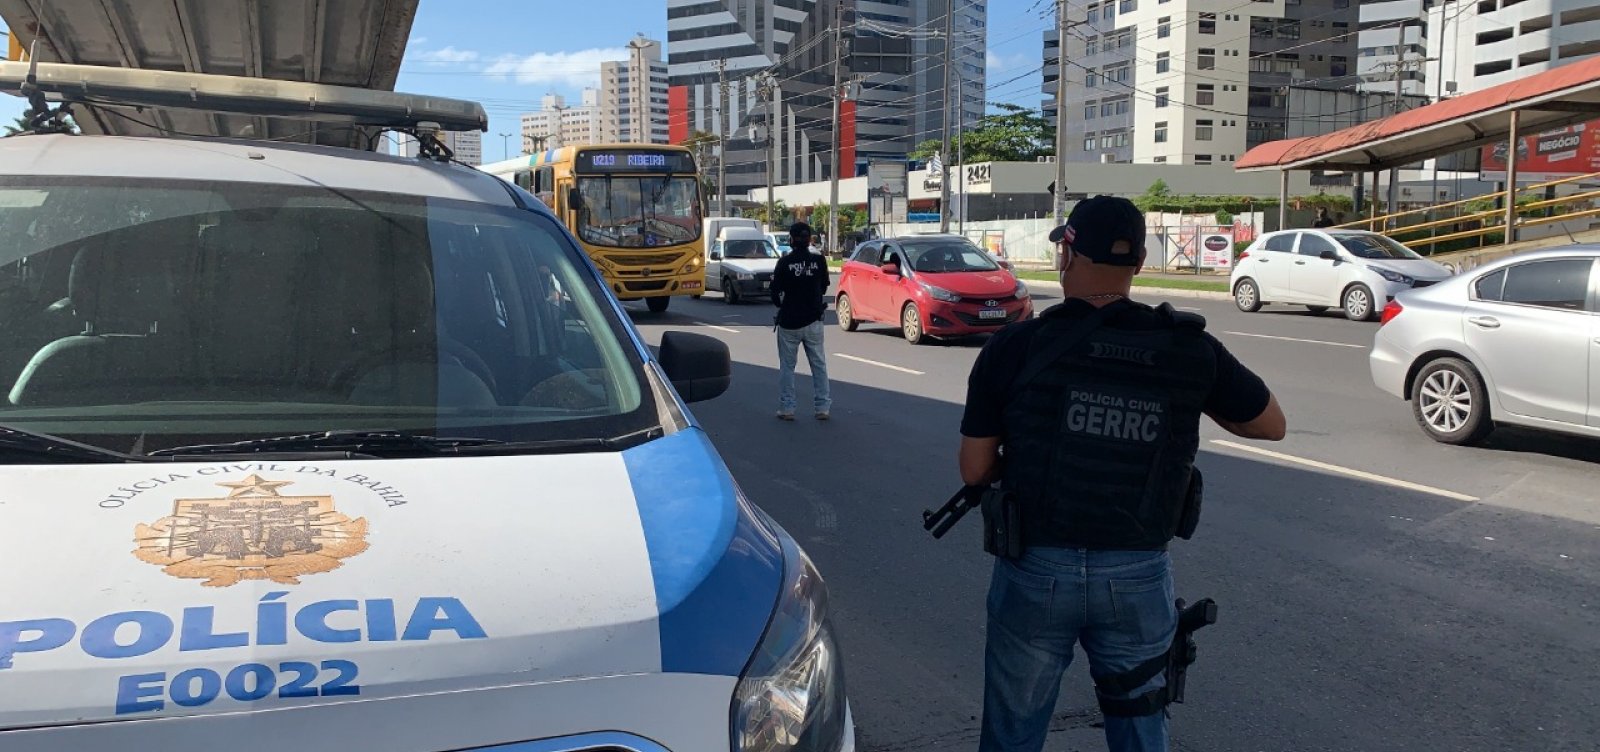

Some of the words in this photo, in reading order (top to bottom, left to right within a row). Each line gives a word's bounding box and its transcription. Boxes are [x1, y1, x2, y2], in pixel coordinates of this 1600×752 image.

[1539, 135, 1580, 152] NEGÓCIO
[628, 154, 665, 165] RIBEIRA
[967, 164, 991, 181] 2421
[789, 261, 818, 271] POLÍIA
[1128, 399, 1164, 413] CIVIL
[1066, 403, 1160, 442] GERRC
[197, 464, 287, 475] CIVIL
[295, 466, 336, 477] DA
[344, 474, 408, 508] BAHIA
[0, 591, 488, 669] POLÍCIA
[115, 661, 361, 715] E0022
